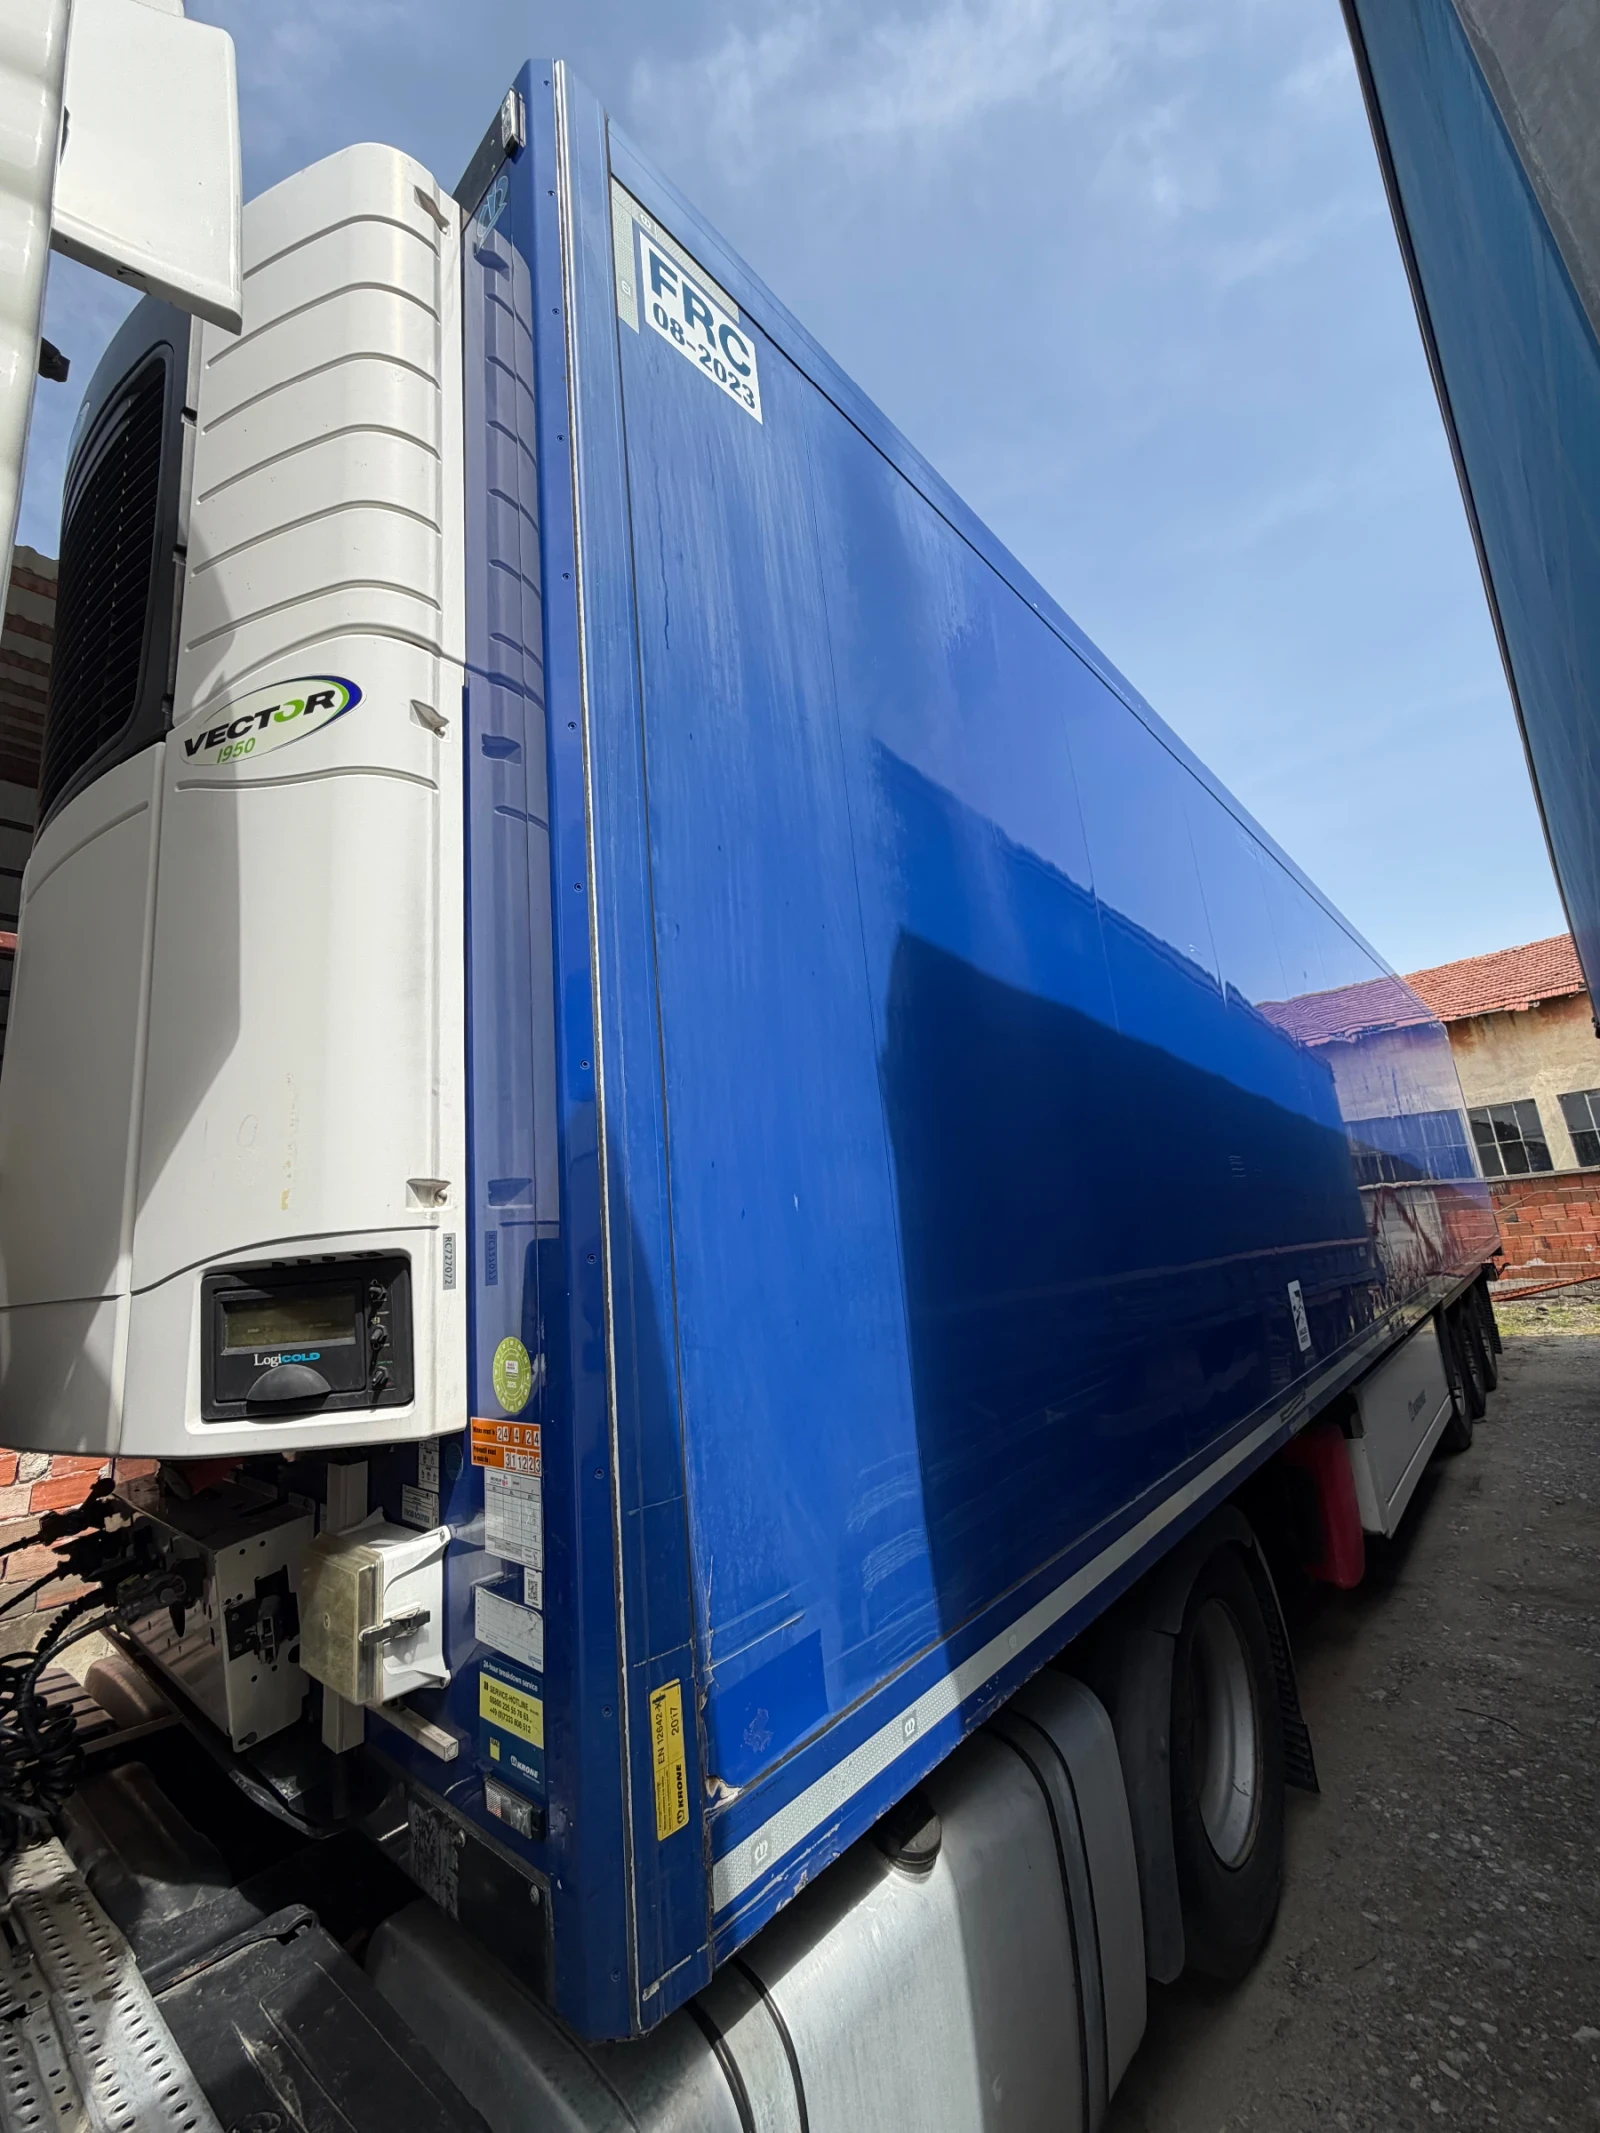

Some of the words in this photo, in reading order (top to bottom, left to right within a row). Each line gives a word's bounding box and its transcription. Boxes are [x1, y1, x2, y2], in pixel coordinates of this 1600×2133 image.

[649, 248, 751, 377] FRC
[653, 303, 755, 409] 08-2023
[184, 690, 336, 757] VECTOR
[217, 737, 256, 764] 1950
[444, 1236, 453, 1285] RC727072
[522, 1679, 538, 1692] service
[670, 1706, 679, 1736] 2017
[517, 1761, 538, 1779] KRONE
[658, 1747, 665, 1765] EN
[676, 1764, 684, 1809] KRONE
